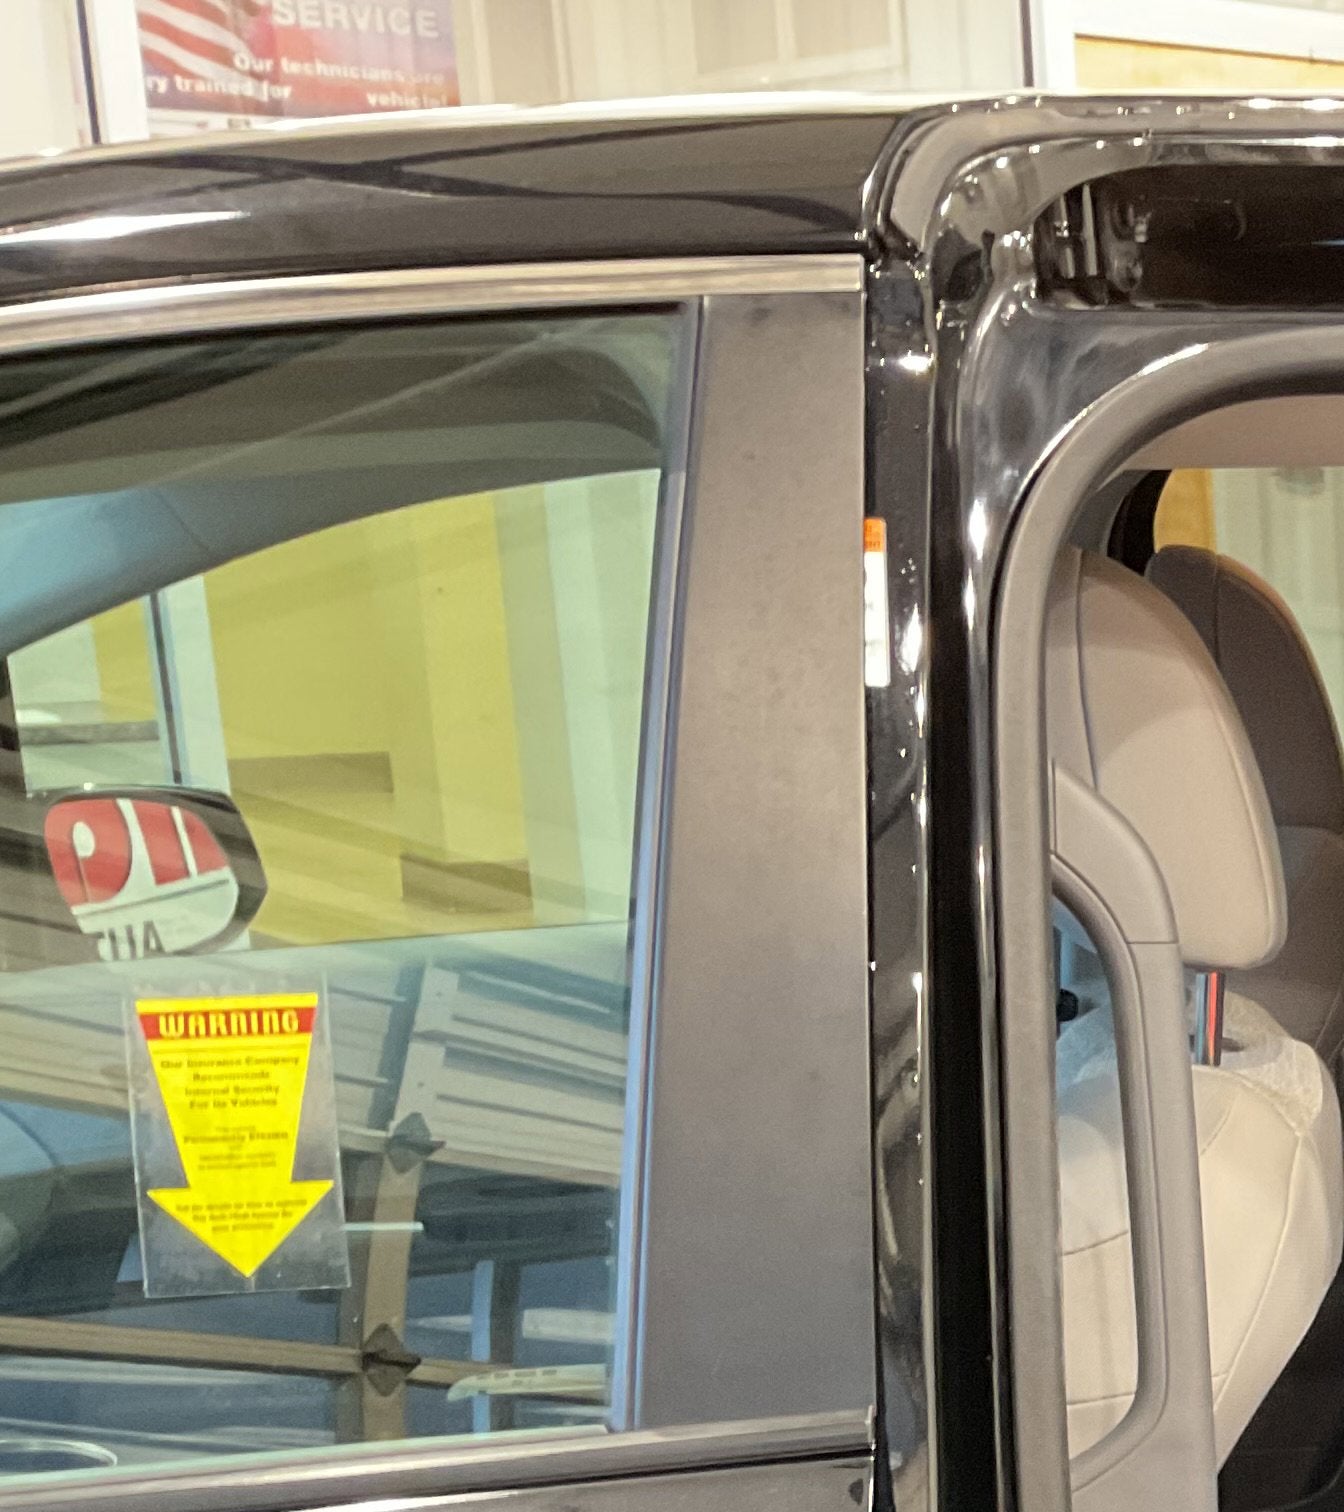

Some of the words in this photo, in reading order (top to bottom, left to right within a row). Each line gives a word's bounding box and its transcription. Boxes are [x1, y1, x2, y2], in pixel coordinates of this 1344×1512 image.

[272, 0, 440, 38] SERVICE
[232, 51, 274, 72] Our
[281, 56, 404, 85] technicians
[174, 75, 256, 97] trained
[158, 1009, 300, 1039] WARNING
